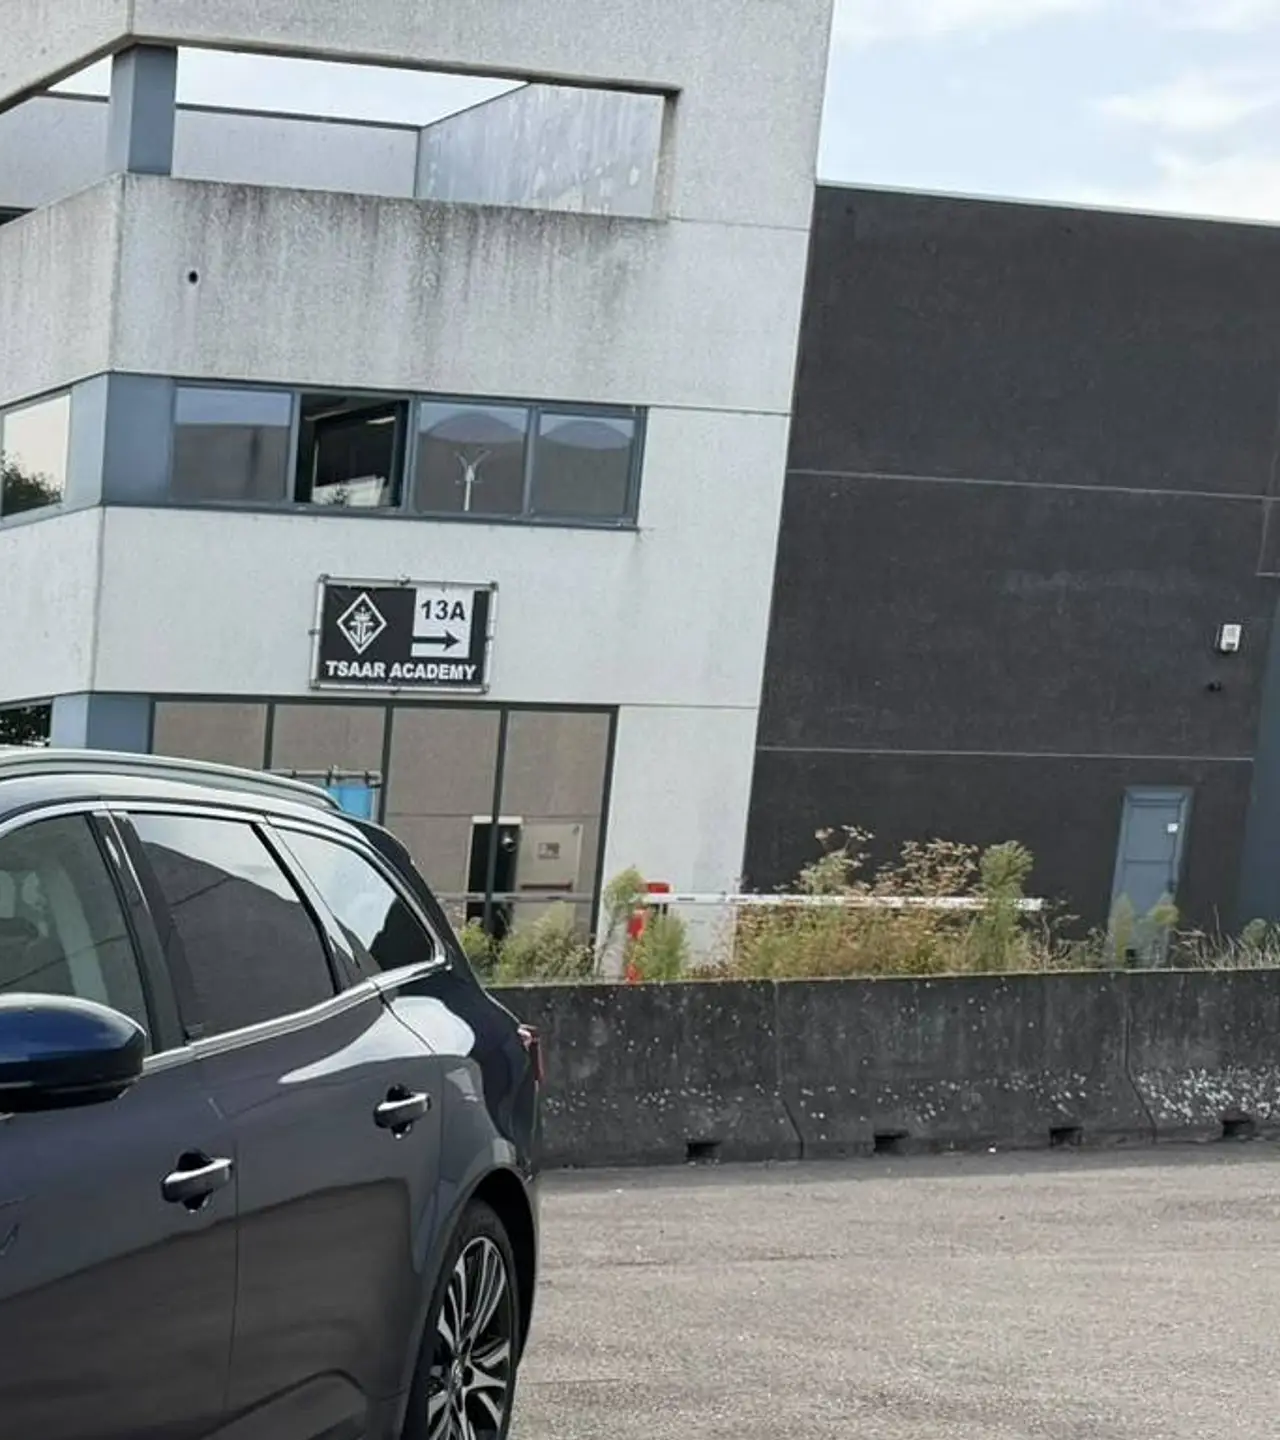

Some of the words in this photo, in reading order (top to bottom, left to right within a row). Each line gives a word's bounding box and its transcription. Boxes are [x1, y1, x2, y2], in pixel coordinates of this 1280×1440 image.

[420, 600, 466, 622] 13A
[325, 661, 386, 678] TSAAR
[390, 663, 476, 680] ACADEMY
